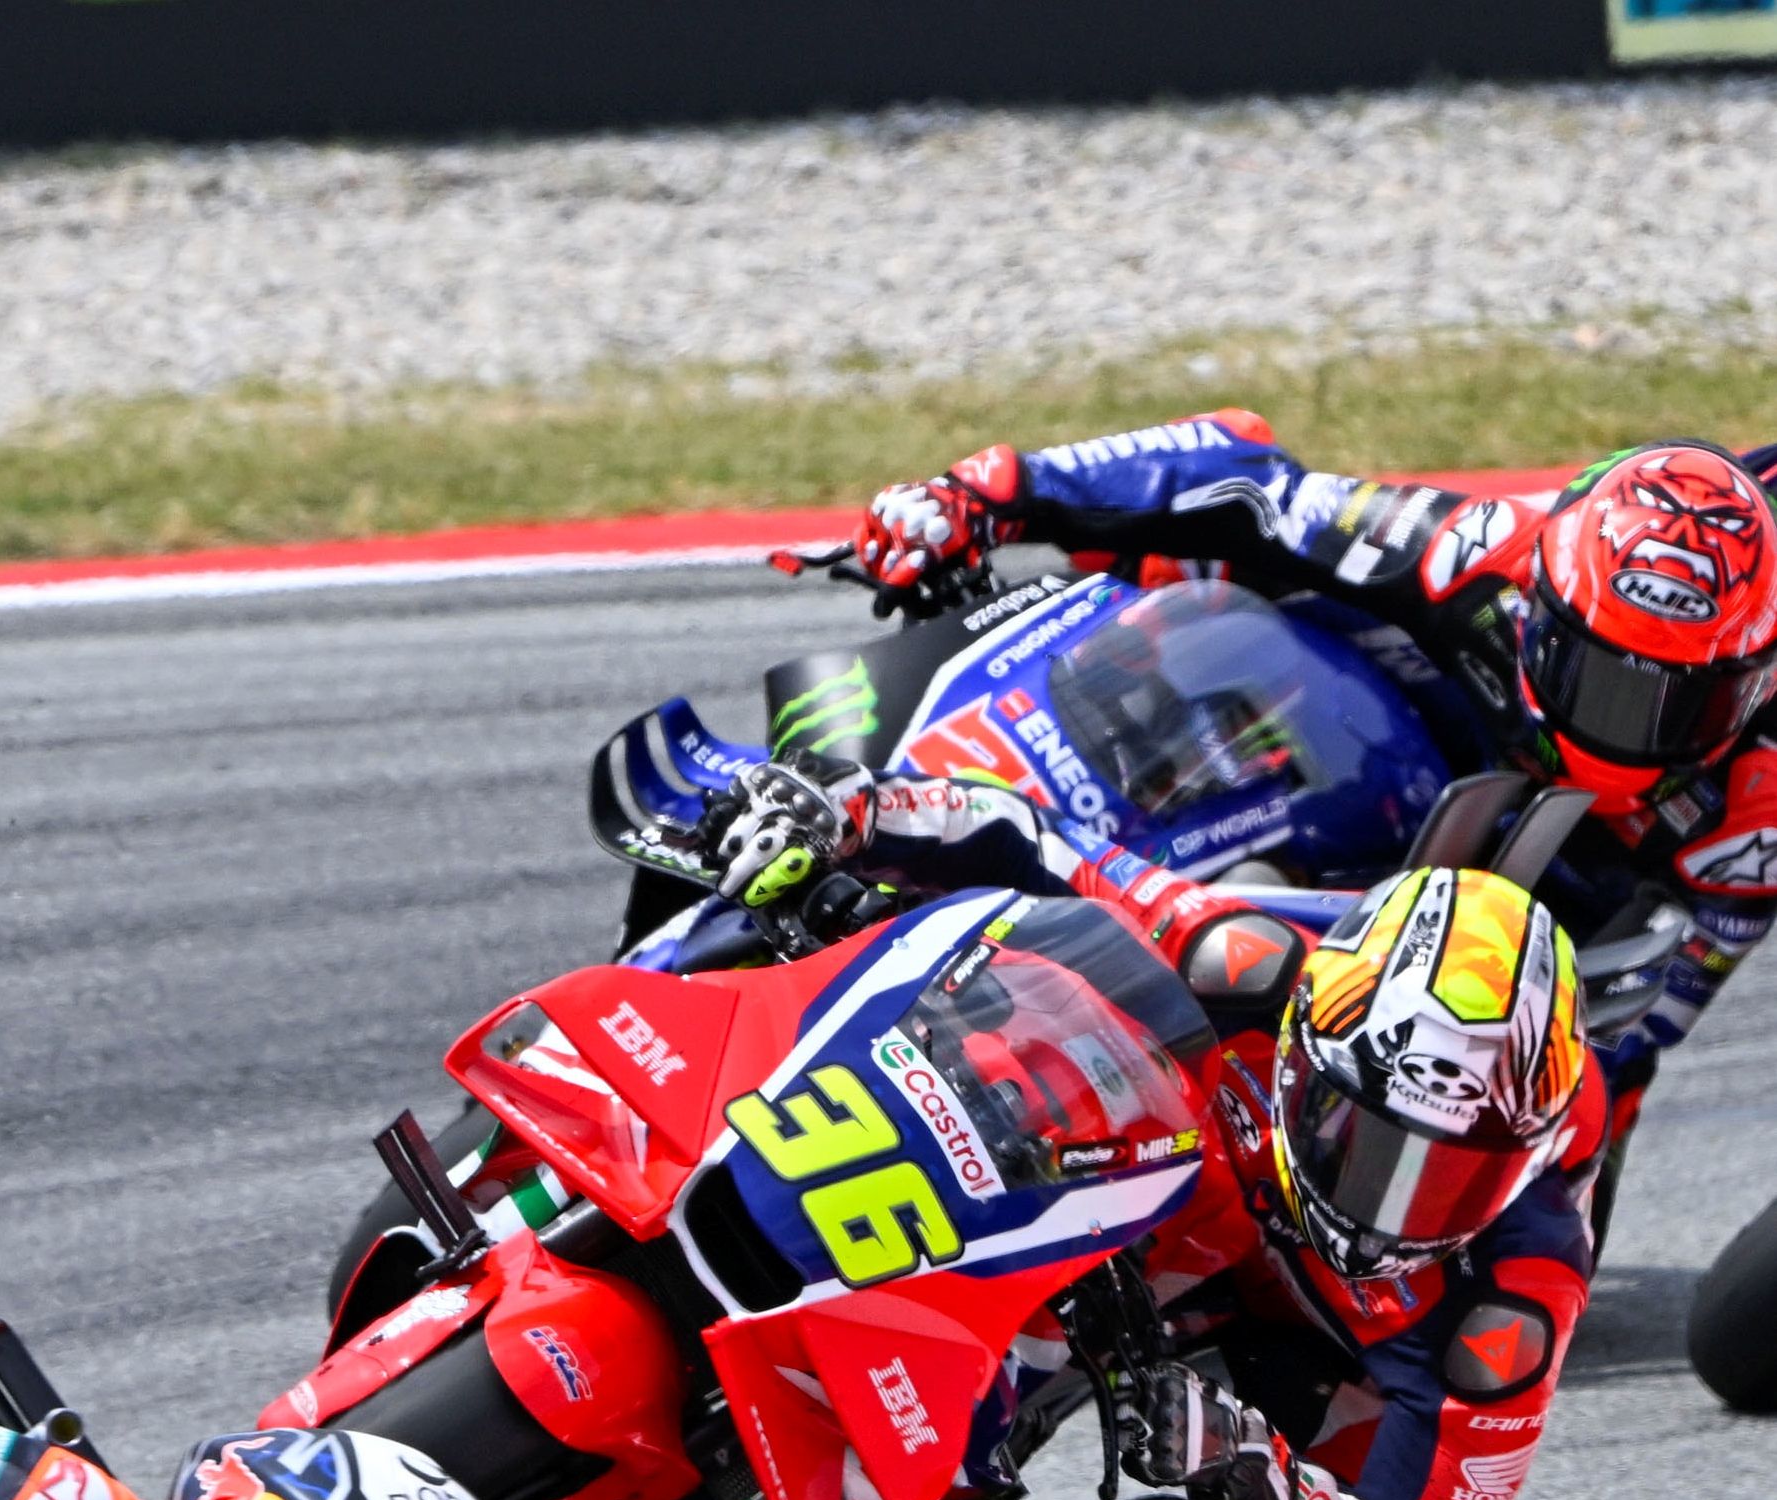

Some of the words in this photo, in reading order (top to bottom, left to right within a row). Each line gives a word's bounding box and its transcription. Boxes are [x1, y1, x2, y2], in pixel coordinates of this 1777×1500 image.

[1014, 709, 1121, 840] ENEOS
[598, 1001, 689, 1086] IBM
[723, 1063, 965, 1289] 36
[903, 1068, 996, 1194] Castrol
[867, 1356, 940, 1455] IBM
